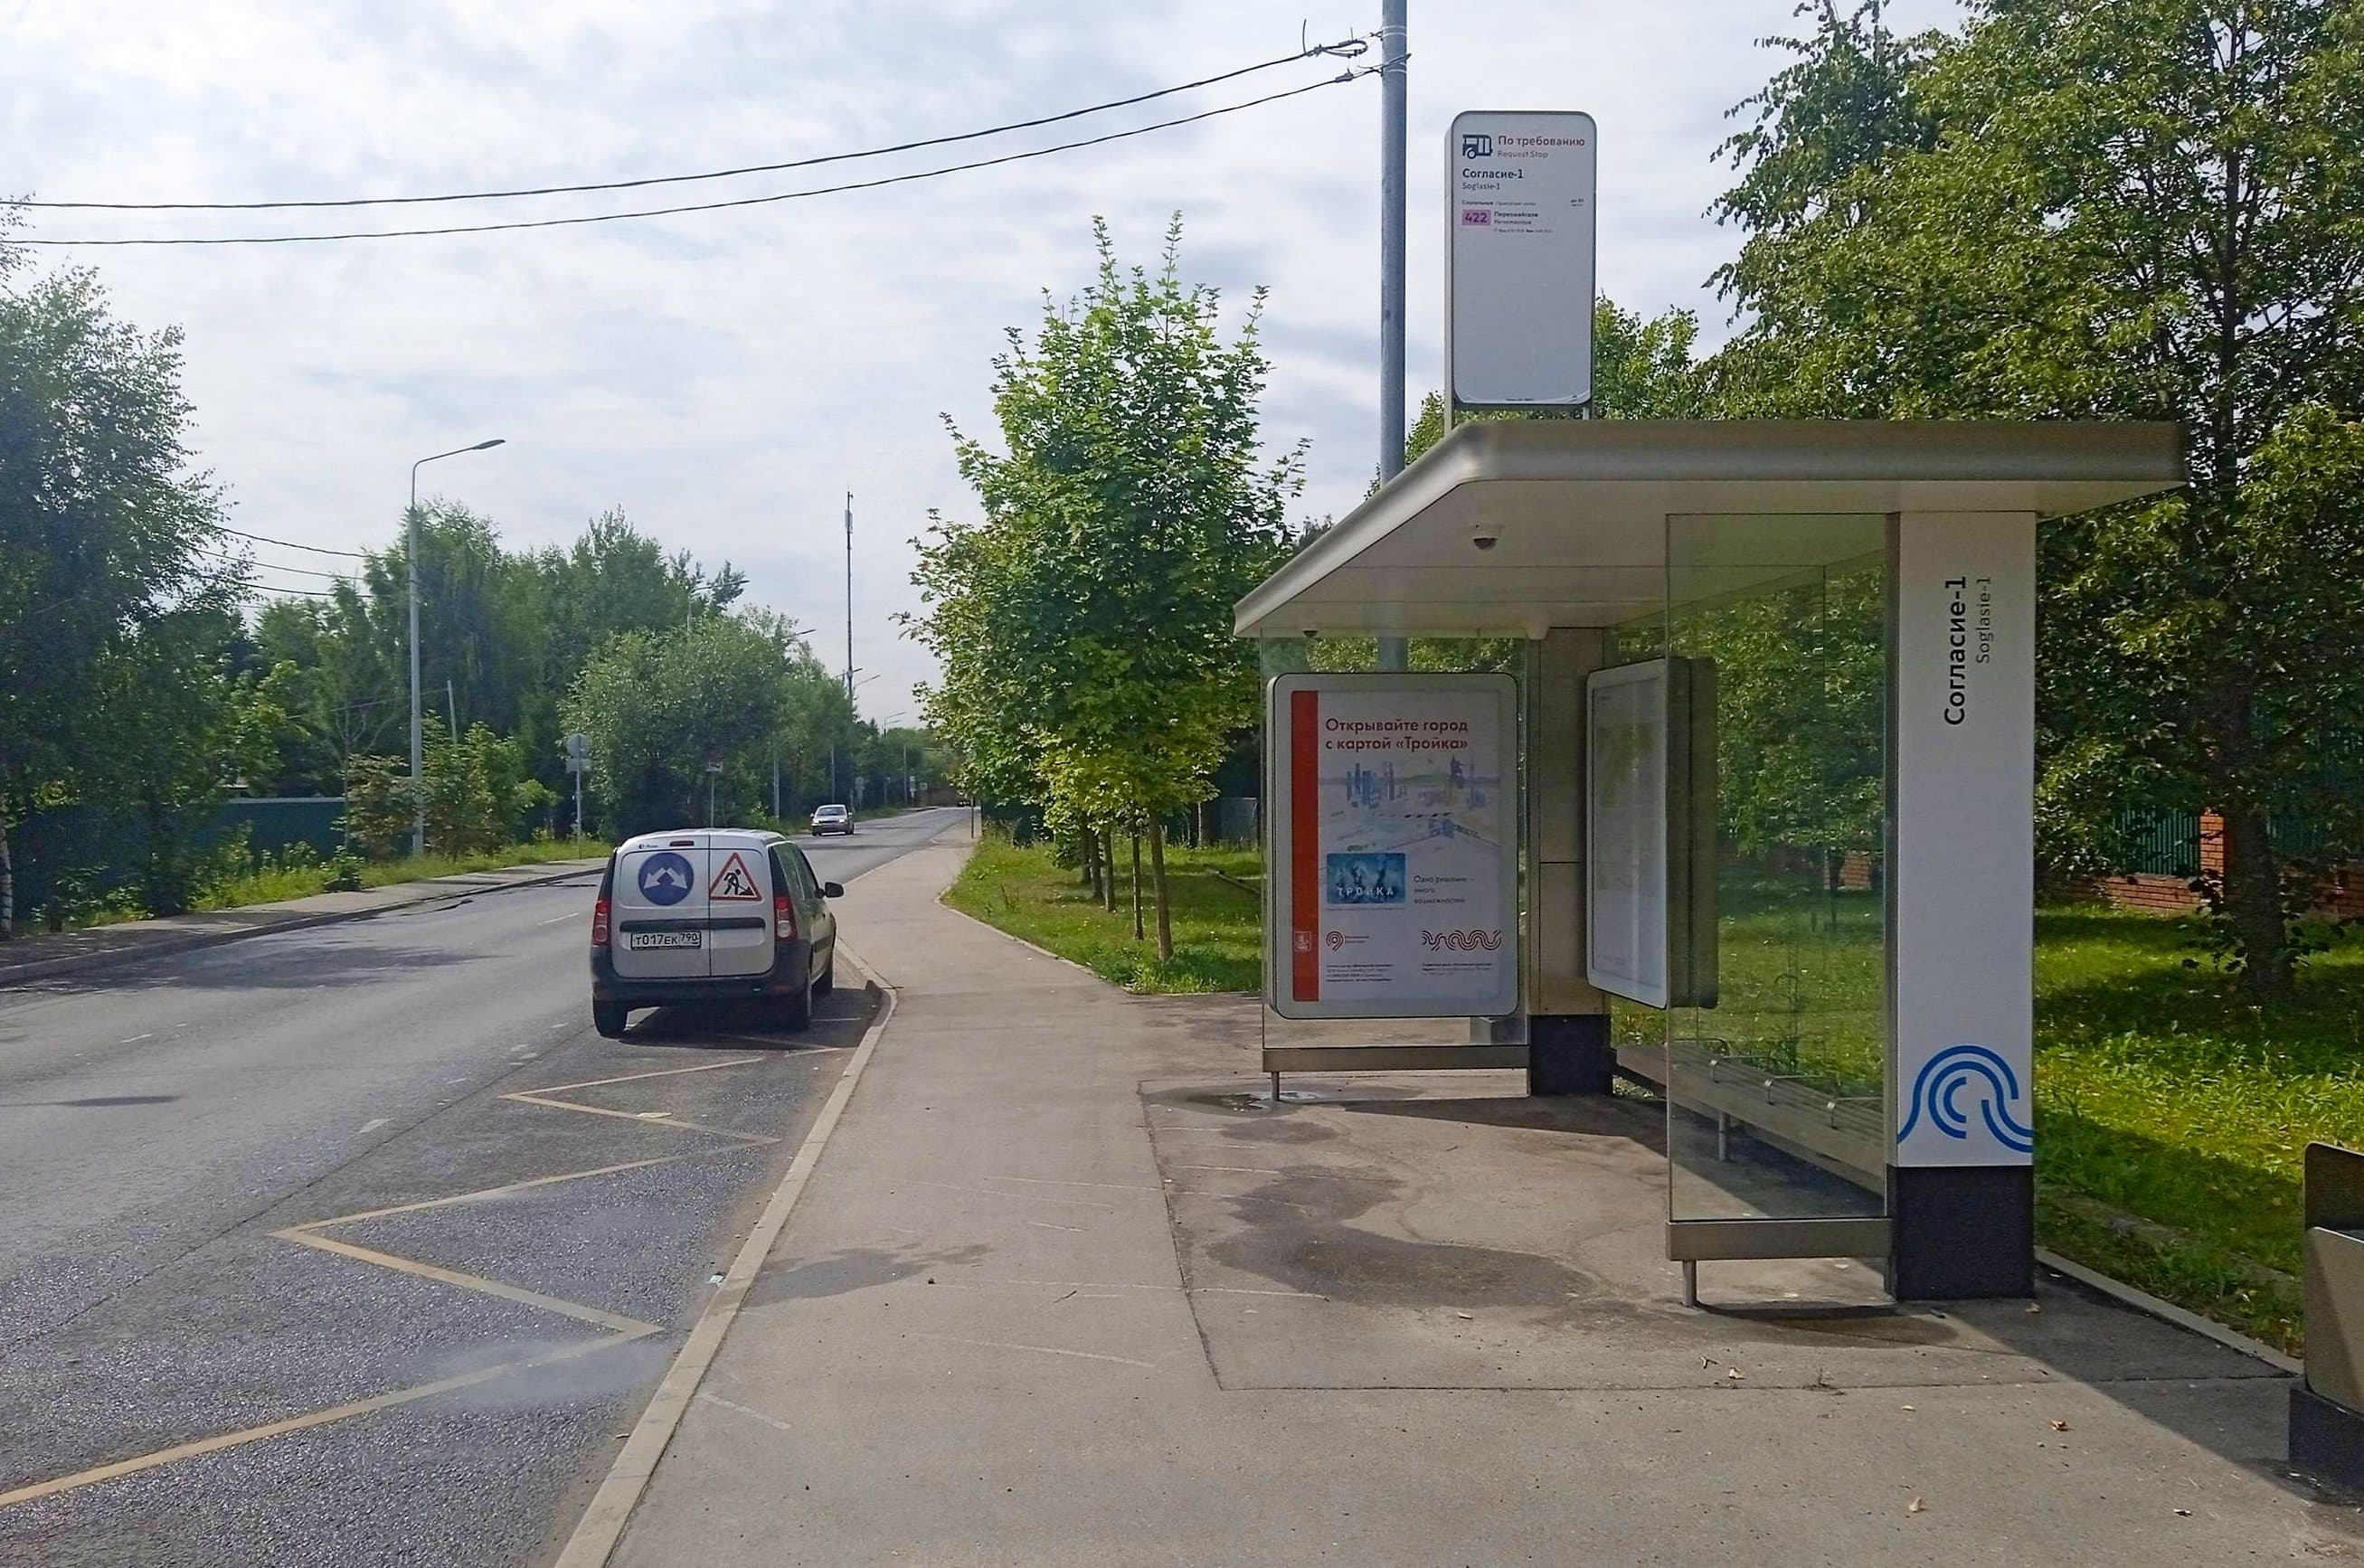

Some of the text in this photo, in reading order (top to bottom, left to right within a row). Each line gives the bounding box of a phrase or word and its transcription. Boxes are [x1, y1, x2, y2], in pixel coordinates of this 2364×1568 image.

[1498, 136, 1585, 147] По требованию
[1530, 150, 1548, 158] Stop
[1462, 168, 1524, 179] Согласие-1
[1461, 183, 1500, 191] Soglasie-1
[1465, 212, 1488, 223] 422
[1976, 577, 1993, 664] Soglasie-1
[1944, 576, 1966, 725] Согласие-1
[1326, 718, 1469, 735] Открывайте город
[1325, 736, 1469, 752] с картой «Тройка»
[635, 933, 697, 946] Т017ЕК 790
